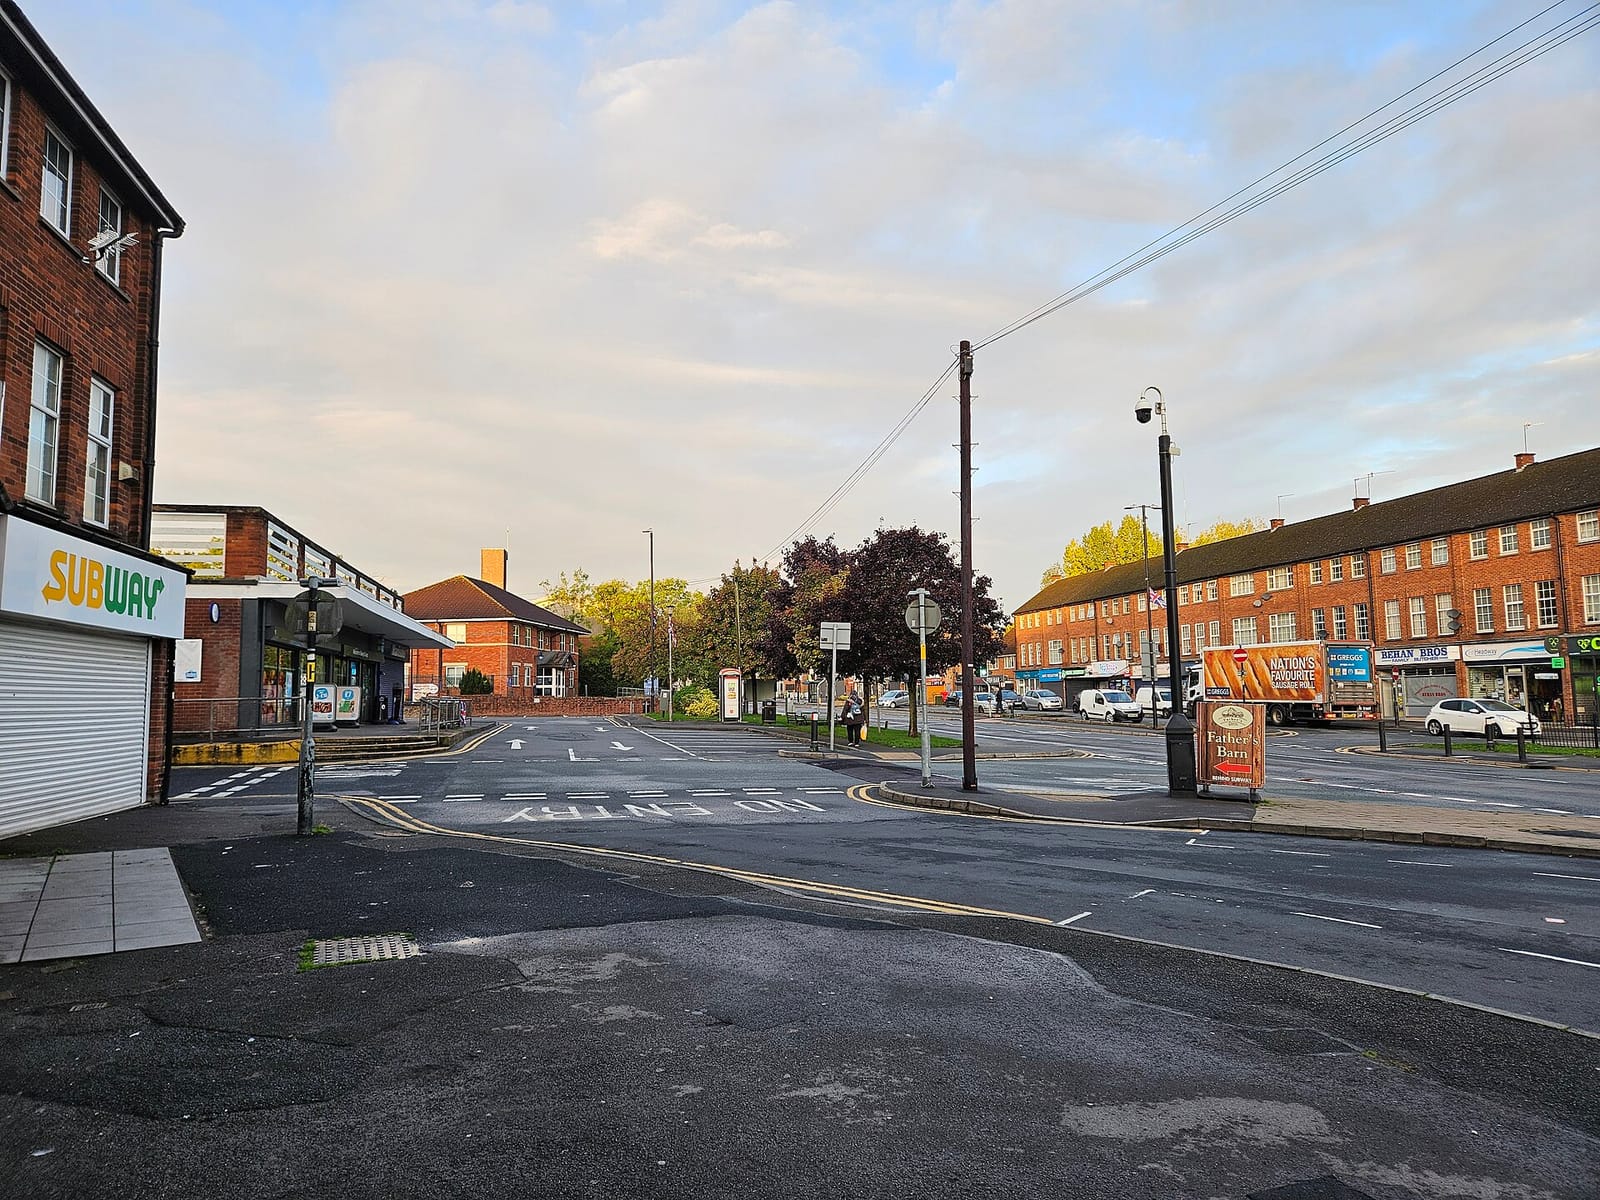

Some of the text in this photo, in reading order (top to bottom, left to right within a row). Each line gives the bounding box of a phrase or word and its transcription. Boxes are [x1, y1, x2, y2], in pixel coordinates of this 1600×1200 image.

[41, 549, 165, 620] SUBWAY
[1381, 647, 1448, 659] BEHAN BROS
[1270, 656, 1315, 669] NATION'S
[1271, 669, 1315, 681] FAVOURITE
[1271, 680, 1315, 689] SAUSAGE ROLL
[1207, 731, 1259, 745] Father's
[1217, 745, 1248, 759] Barn
[502, 798, 827, 823] NO ENTRY
